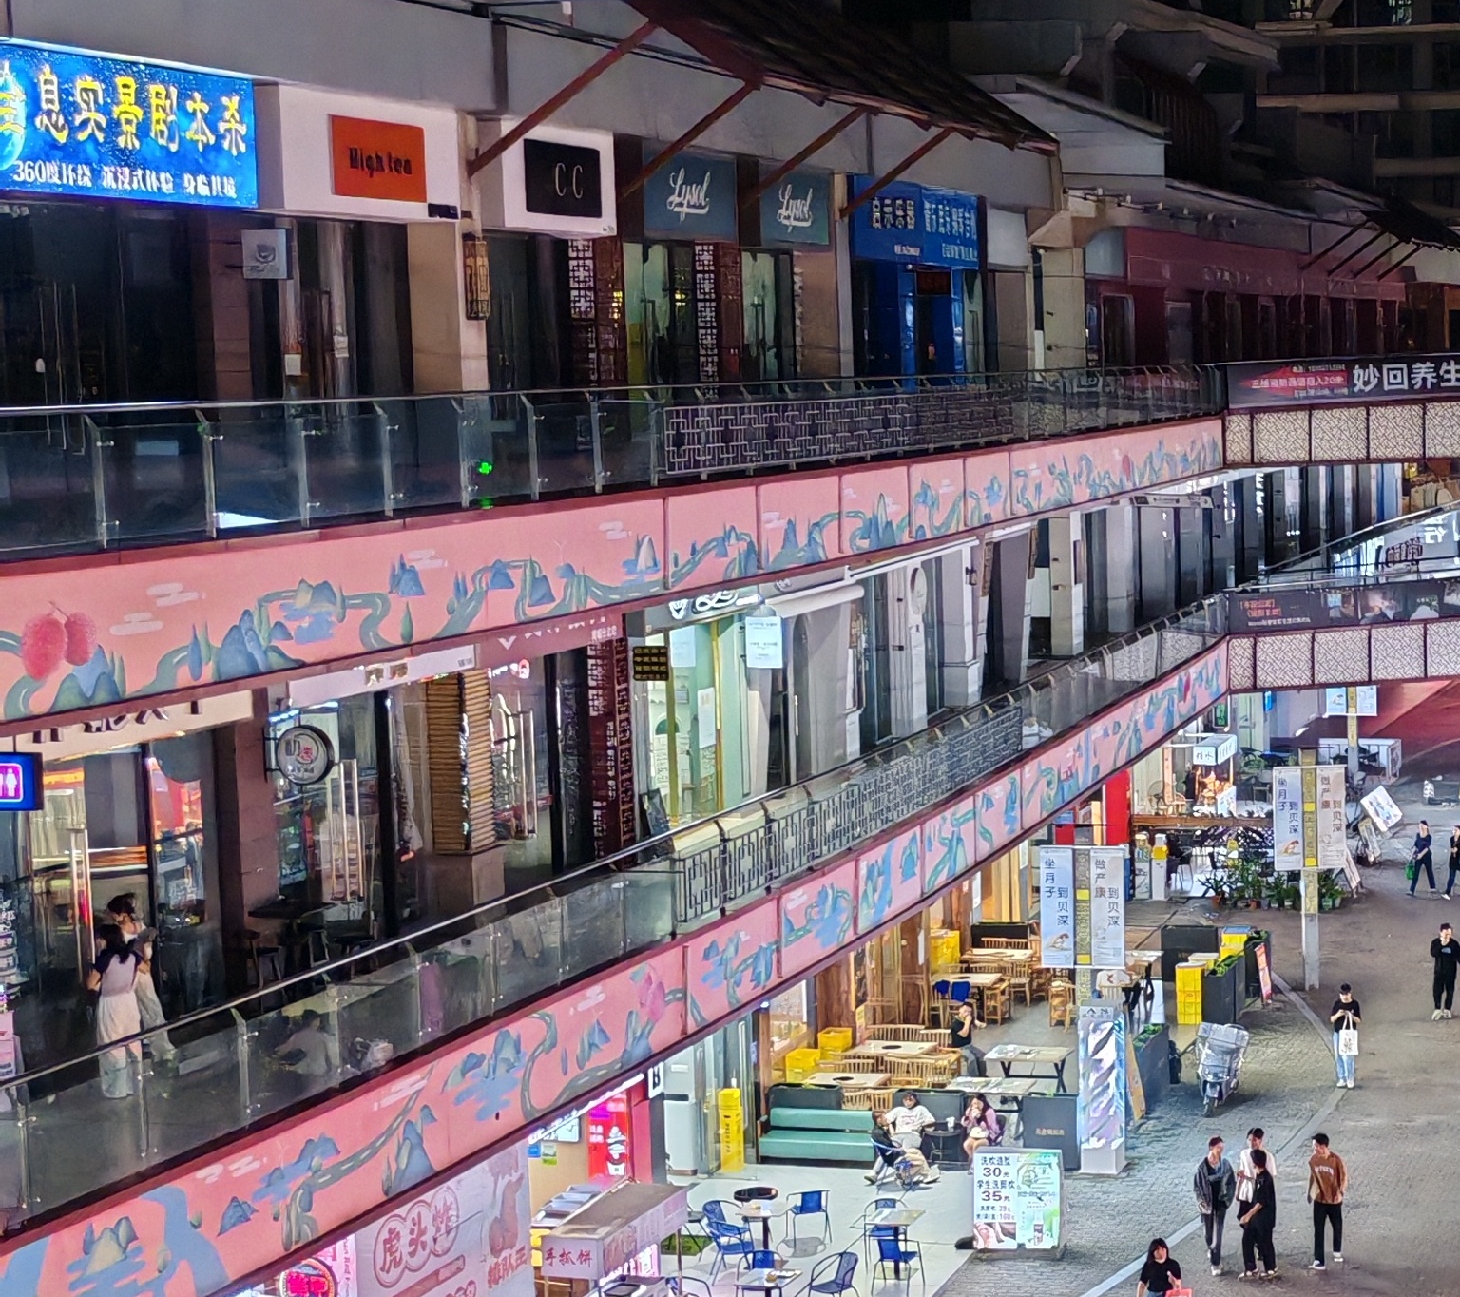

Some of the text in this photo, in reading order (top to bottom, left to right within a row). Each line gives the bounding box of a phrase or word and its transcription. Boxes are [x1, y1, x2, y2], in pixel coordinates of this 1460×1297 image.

[555, 162, 584, 199] CC
[544, 1247, 593, 1268] 手抓饼
